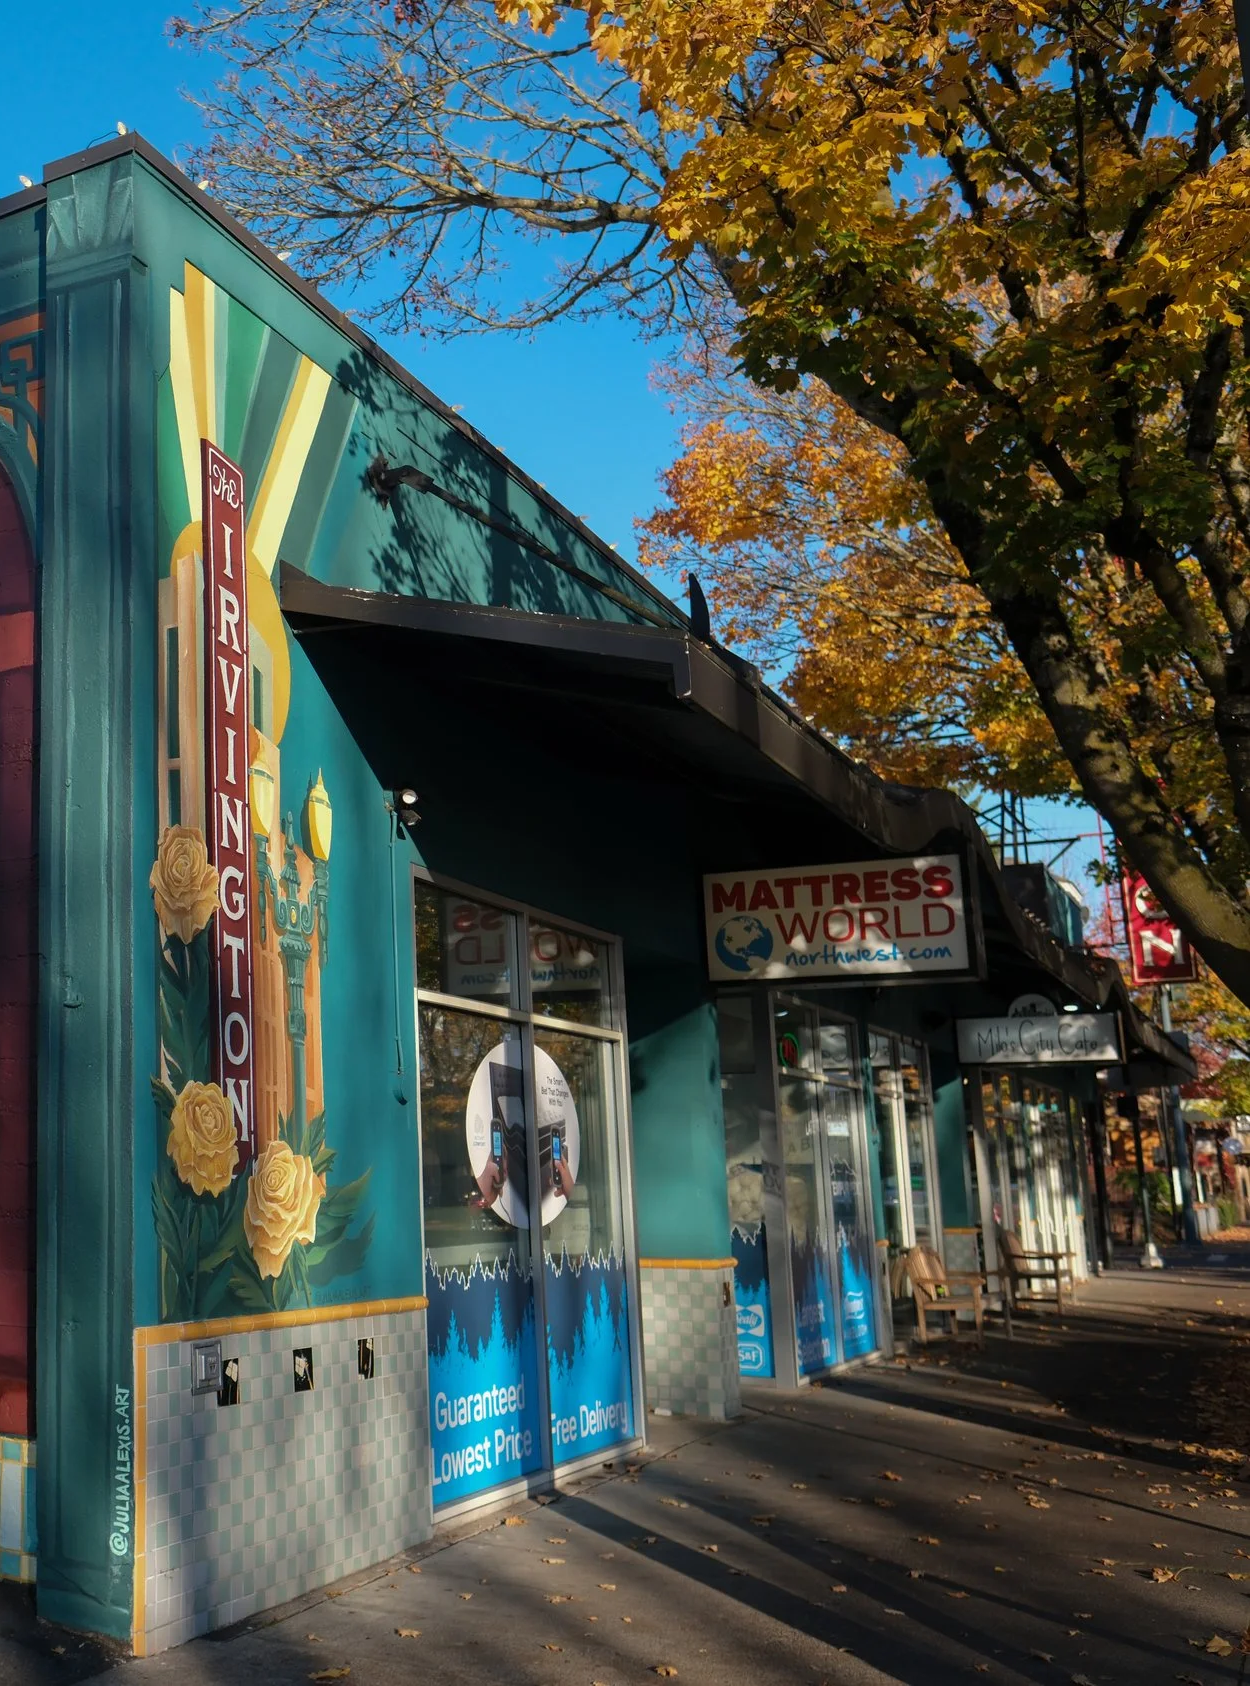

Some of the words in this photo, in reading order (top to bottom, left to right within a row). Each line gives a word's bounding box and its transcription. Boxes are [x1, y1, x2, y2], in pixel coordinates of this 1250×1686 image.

[216, 521, 251, 1142] IRVINGTON
[711, 865, 955, 914] MATTRESS
[774, 902, 956, 946] WORLD
[785, 942, 953, 967] northwest.com
[976, 1024, 1017, 1058] Milo's
[1018, 1019, 1054, 1059] City
[434, 1372, 526, 1432] Guaranteed
[550, 1412, 578, 1446] Free
[579, 1399, 629, 1438] Delivery
[108, 1383, 131, 1557] @JULIAALEXIS.ART
[431, 1433, 492, 1487] Lowest
[494, 1425, 533, 1467] Price
